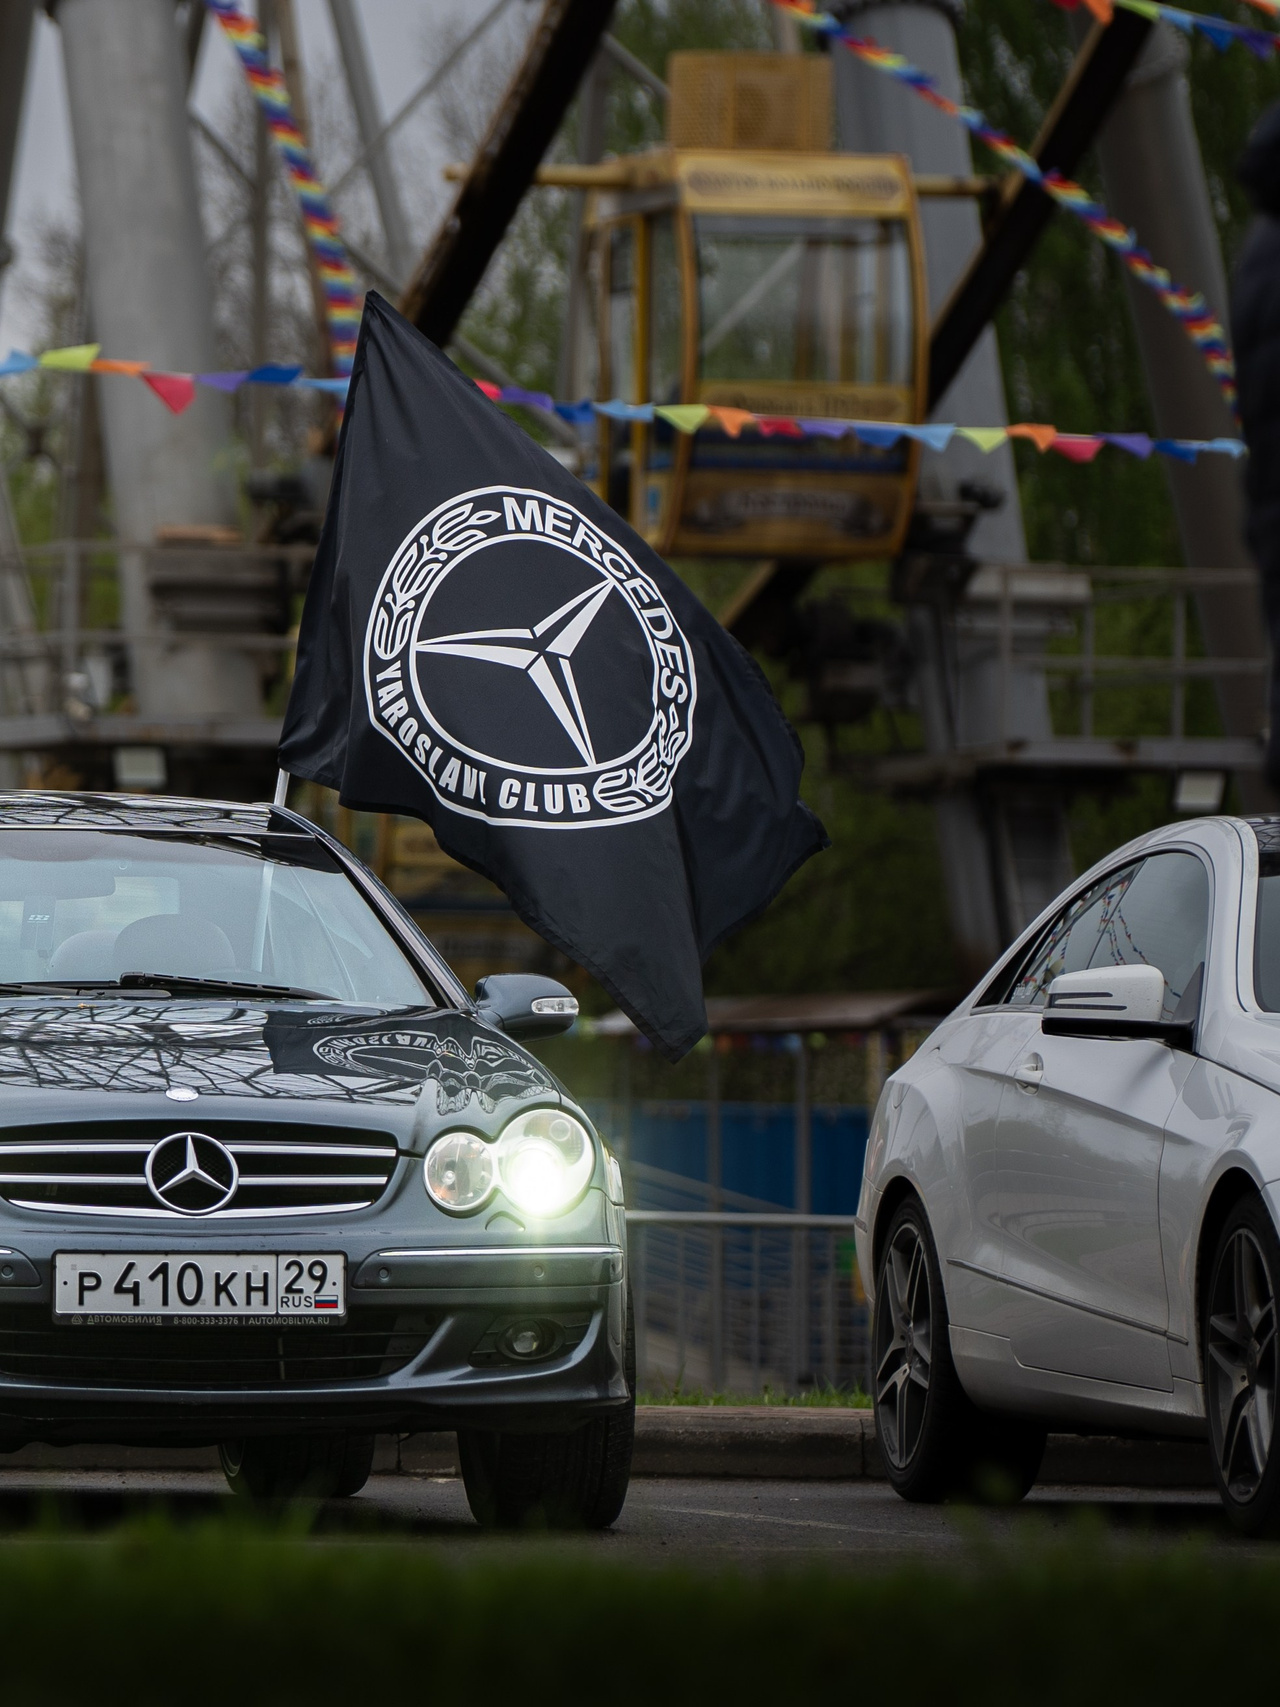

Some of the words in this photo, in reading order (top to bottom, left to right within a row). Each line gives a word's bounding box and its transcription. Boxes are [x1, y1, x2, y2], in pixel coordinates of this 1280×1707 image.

[502, 496, 688, 704] MERCEDES
[498, 778, 592, 815] CLUB
[284, 1258, 329, 1294] 29
[280, 1295, 313, 1309] RUS
[248, 1316, 330, 1326] AUTOMOBILIYA.RU
